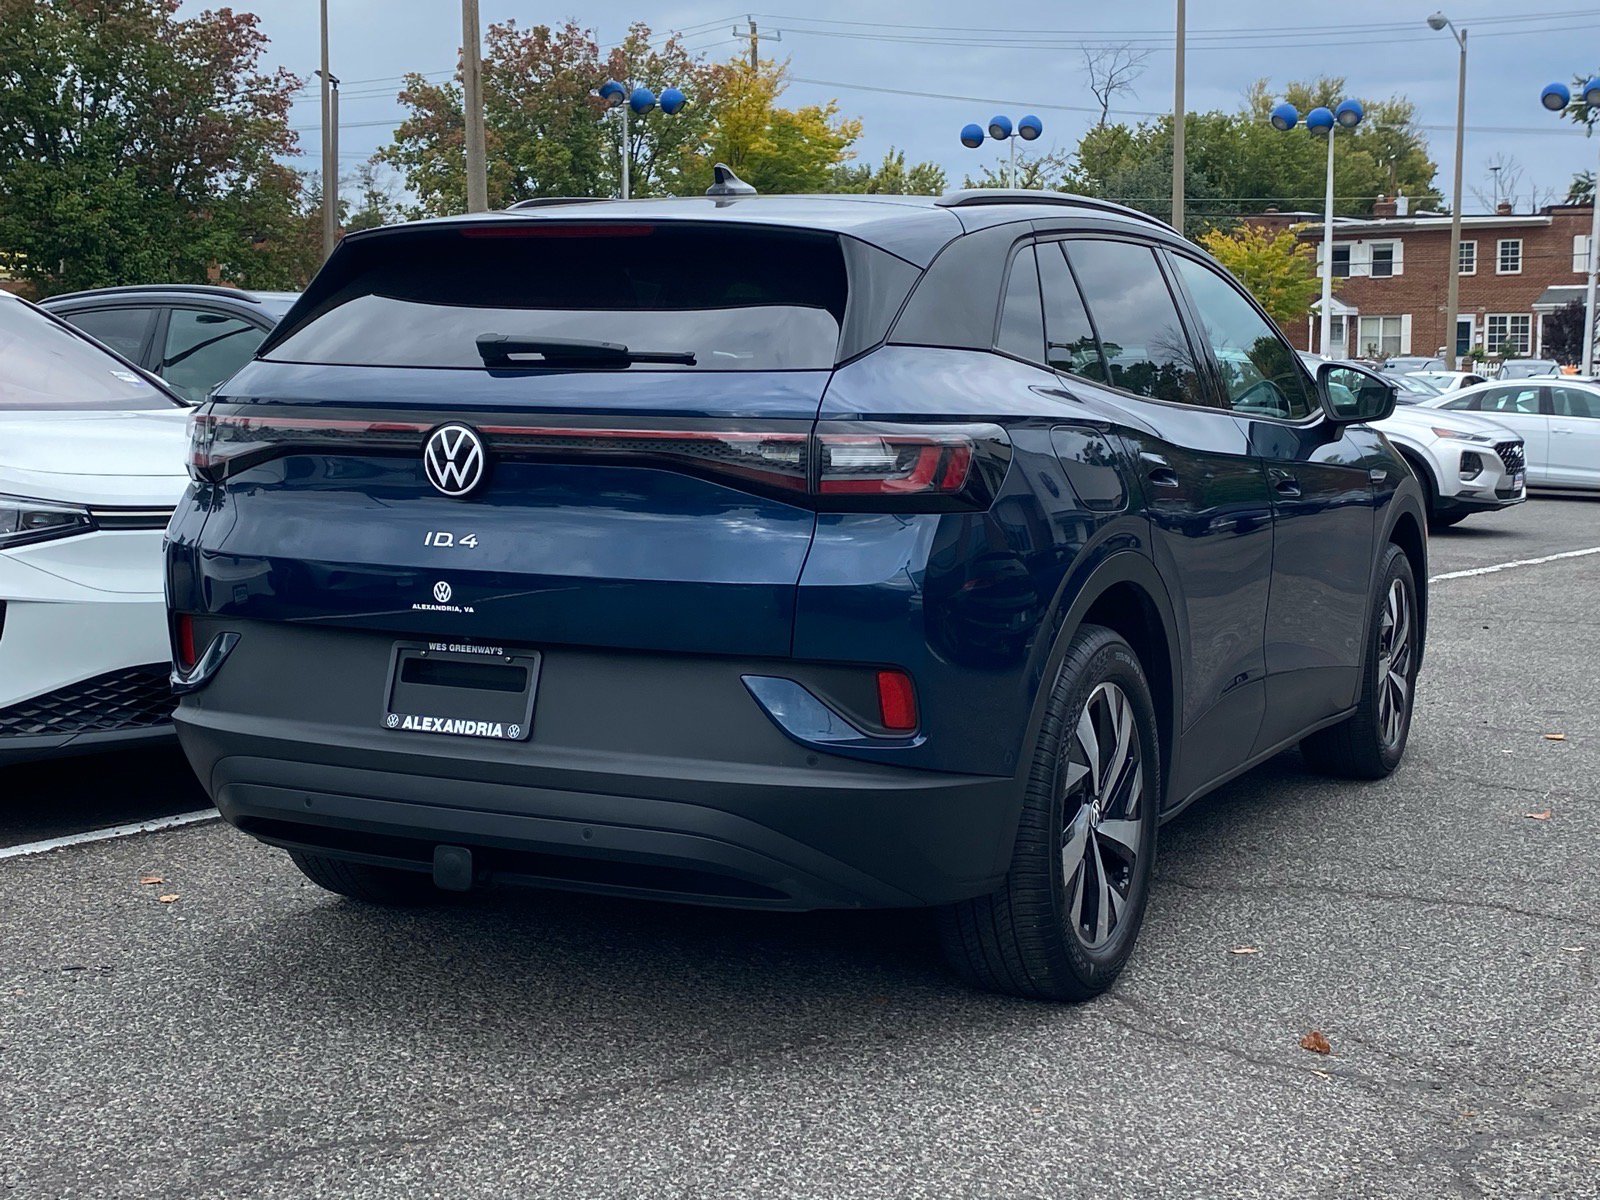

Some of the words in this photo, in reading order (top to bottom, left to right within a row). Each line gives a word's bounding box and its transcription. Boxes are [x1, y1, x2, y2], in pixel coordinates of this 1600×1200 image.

[424, 425, 484, 496] VW
[412, 603, 462, 613] ALEXANDRIA,
[428, 642, 447, 651] WES
[449, 644, 503, 655] GREENWAY'S
[401, 715, 503, 737] ALEXANDRIA
